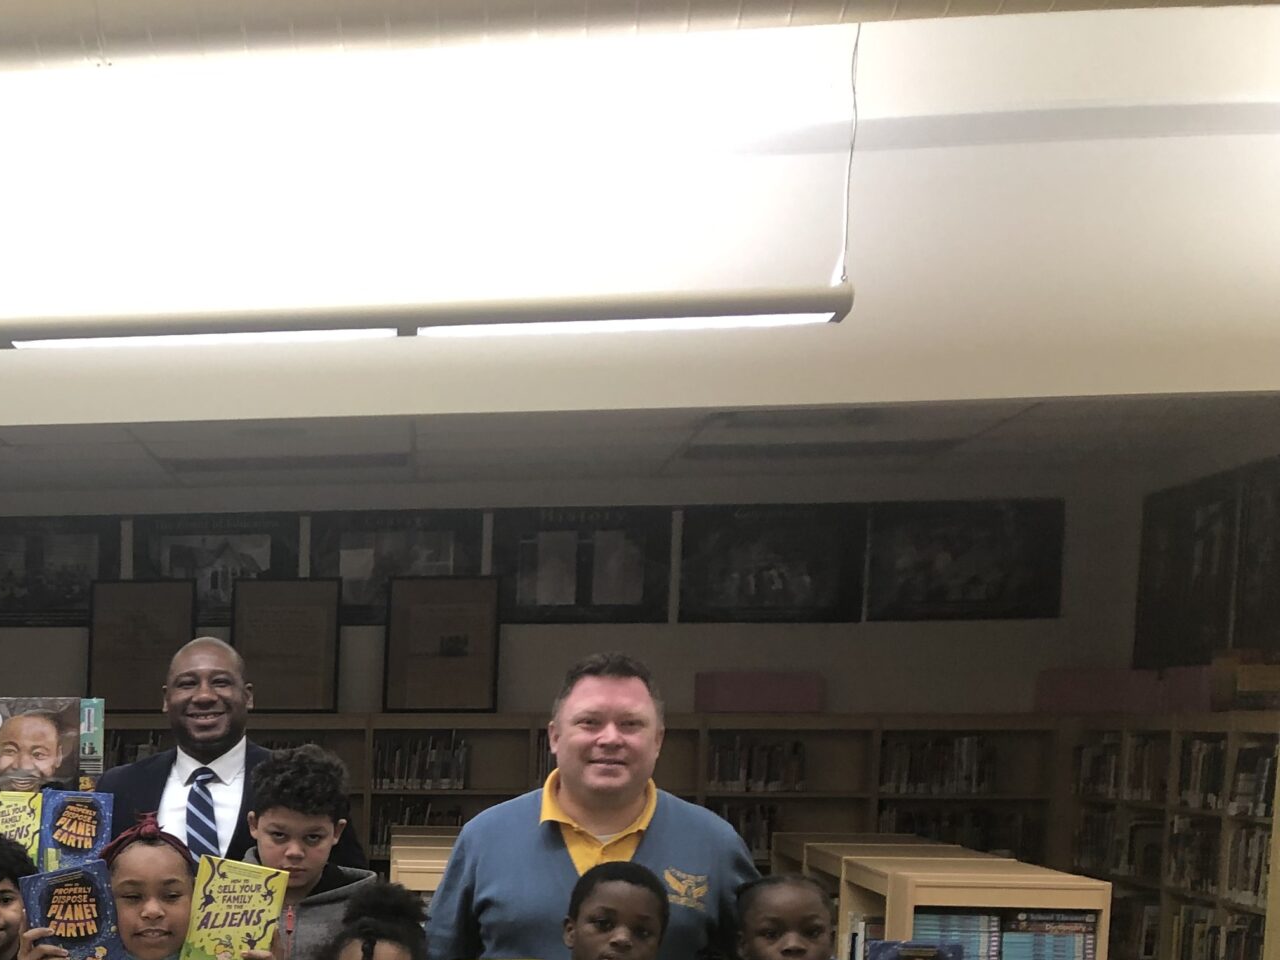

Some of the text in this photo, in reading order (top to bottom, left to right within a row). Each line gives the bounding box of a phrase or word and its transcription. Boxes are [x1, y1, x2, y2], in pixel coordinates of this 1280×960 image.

[55, 816, 96, 837] PLANET
[52, 829, 93, 849] EARTH
[53, 886, 91, 896] PROPERLY
[217, 884, 262, 894] SELL YOUR
[51, 894, 88, 904] DISPOSE
[222, 895, 253, 904] FAMILY
[46, 903, 99, 920] PLANET
[196, 909, 266, 931] ALIENS
[48, 920, 98, 938] EARTH
